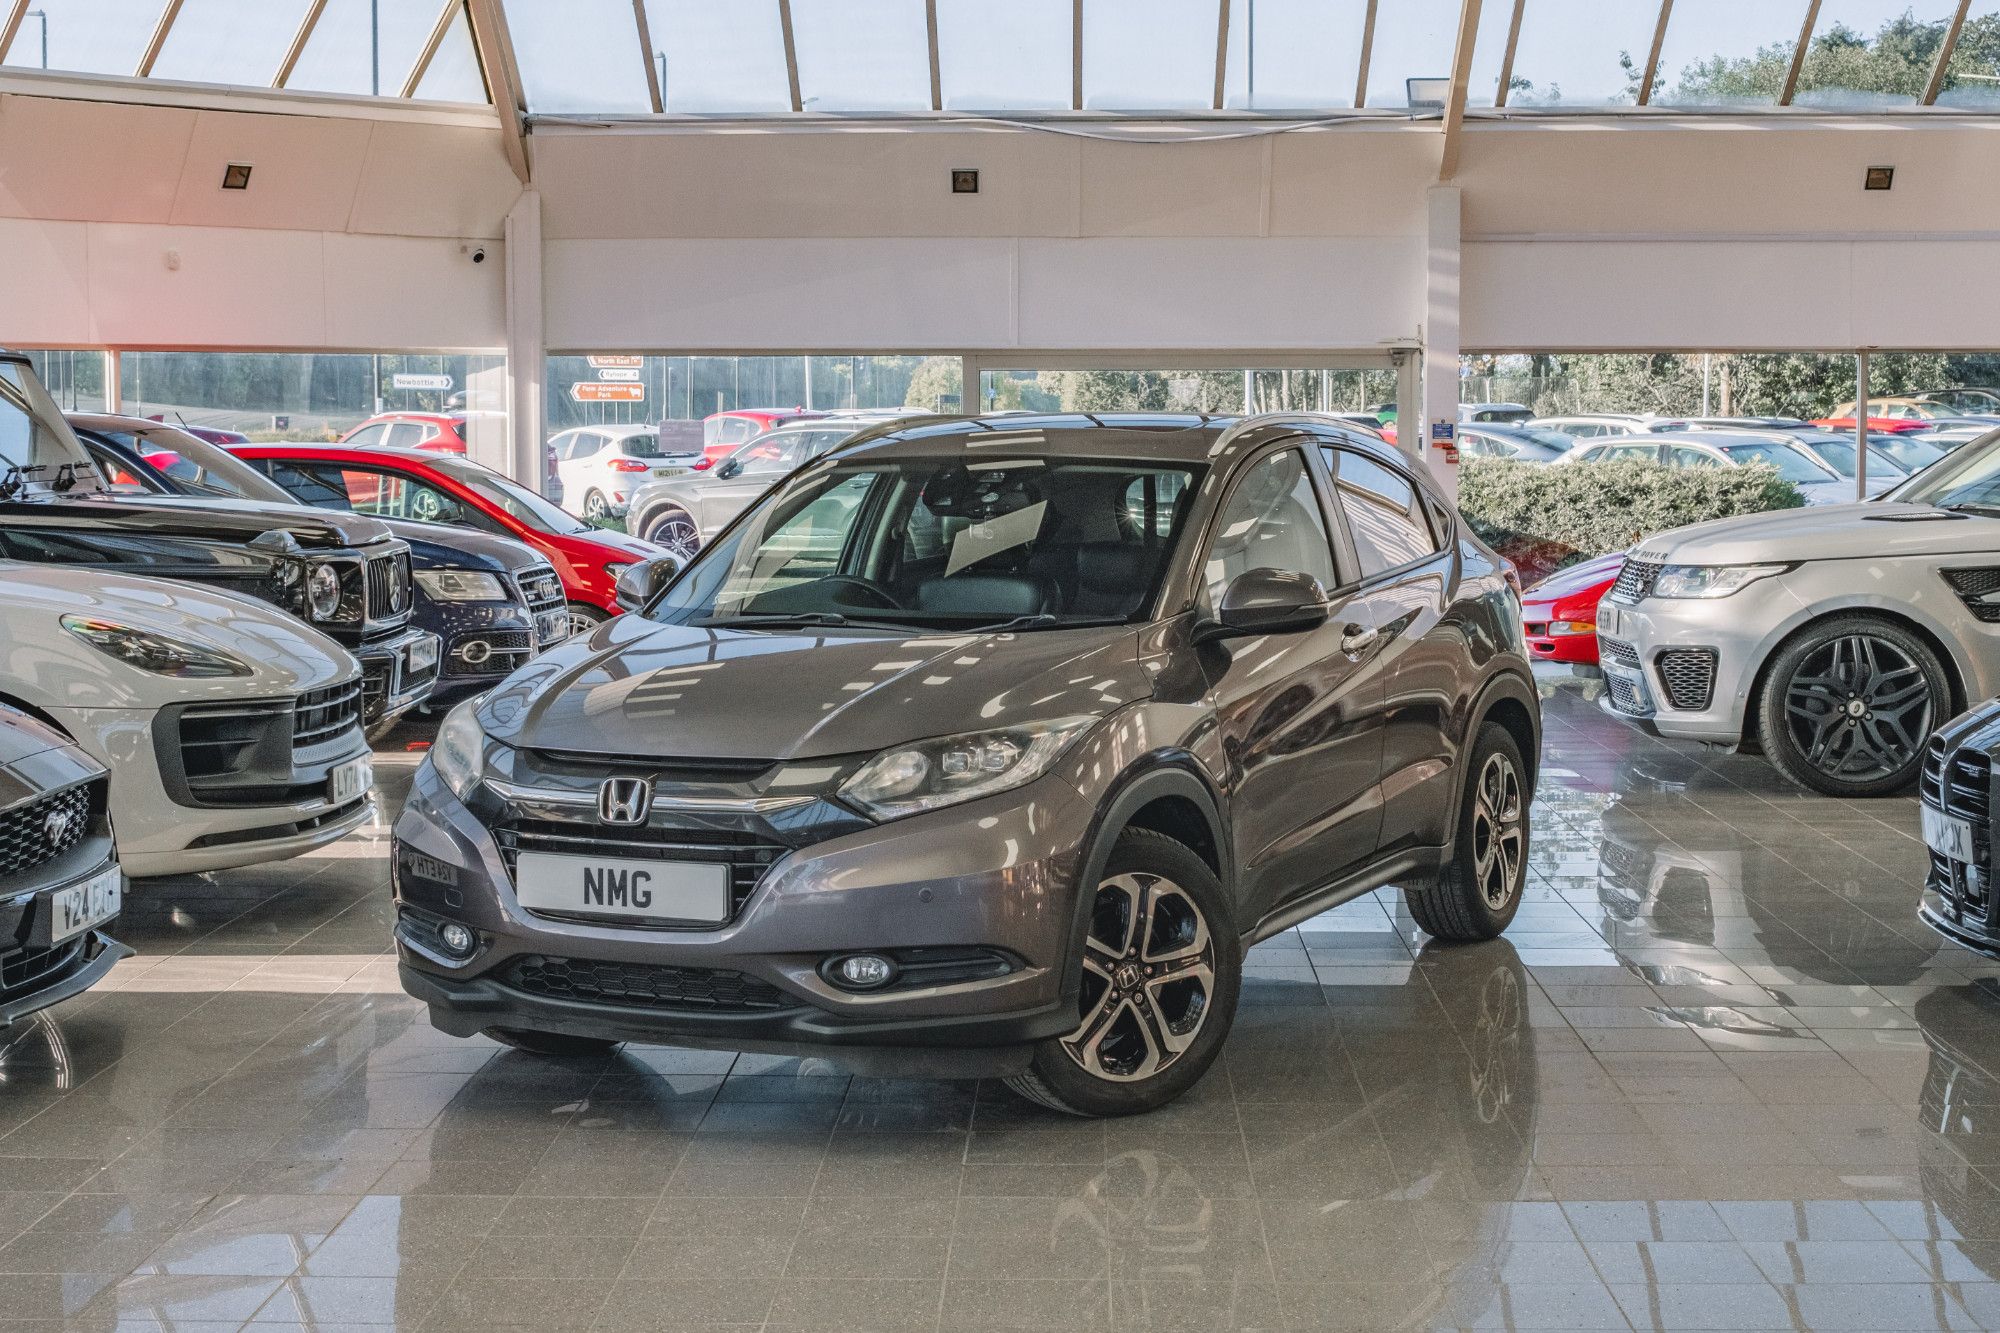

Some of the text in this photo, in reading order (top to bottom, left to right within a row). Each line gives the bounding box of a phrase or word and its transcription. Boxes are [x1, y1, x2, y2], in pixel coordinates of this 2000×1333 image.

[397, 378, 435, 386] Newbottle
[1641, 550, 1668, 560] ROVER
[583, 867, 652, 909] NMG
[64, 887, 89, 929] V24
